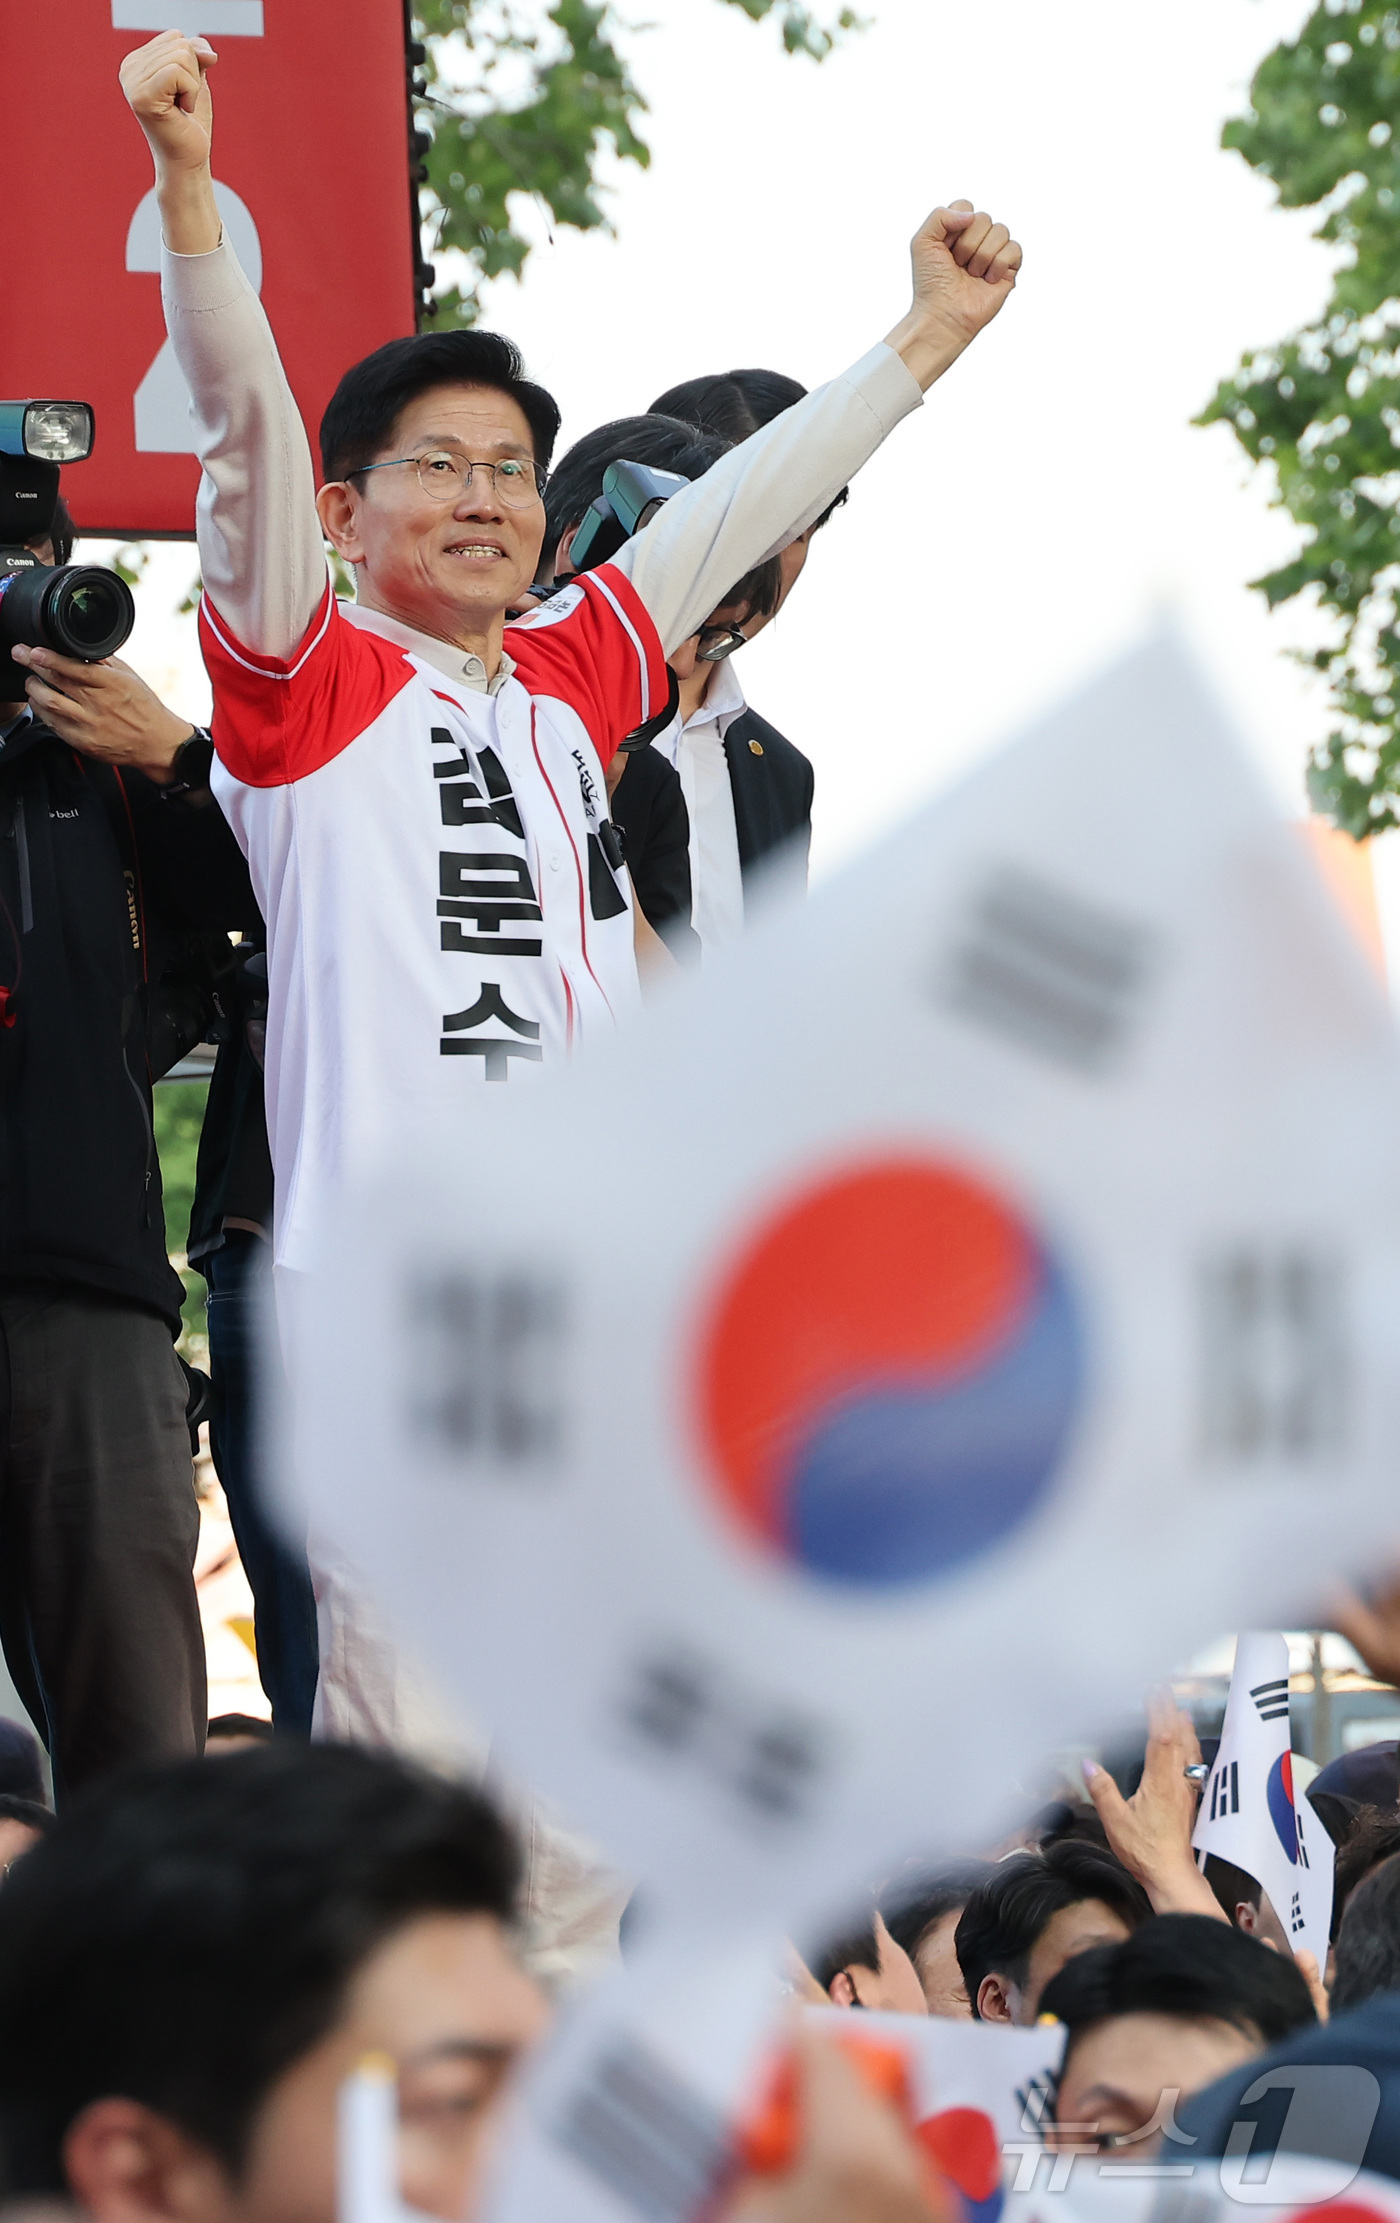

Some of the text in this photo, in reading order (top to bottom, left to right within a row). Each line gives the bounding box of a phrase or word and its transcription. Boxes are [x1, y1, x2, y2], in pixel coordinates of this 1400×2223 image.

[15, 491, 38, 499] Canon
[6, 557, 35, 567] Canon
[123, 870, 140, 949] Canon
